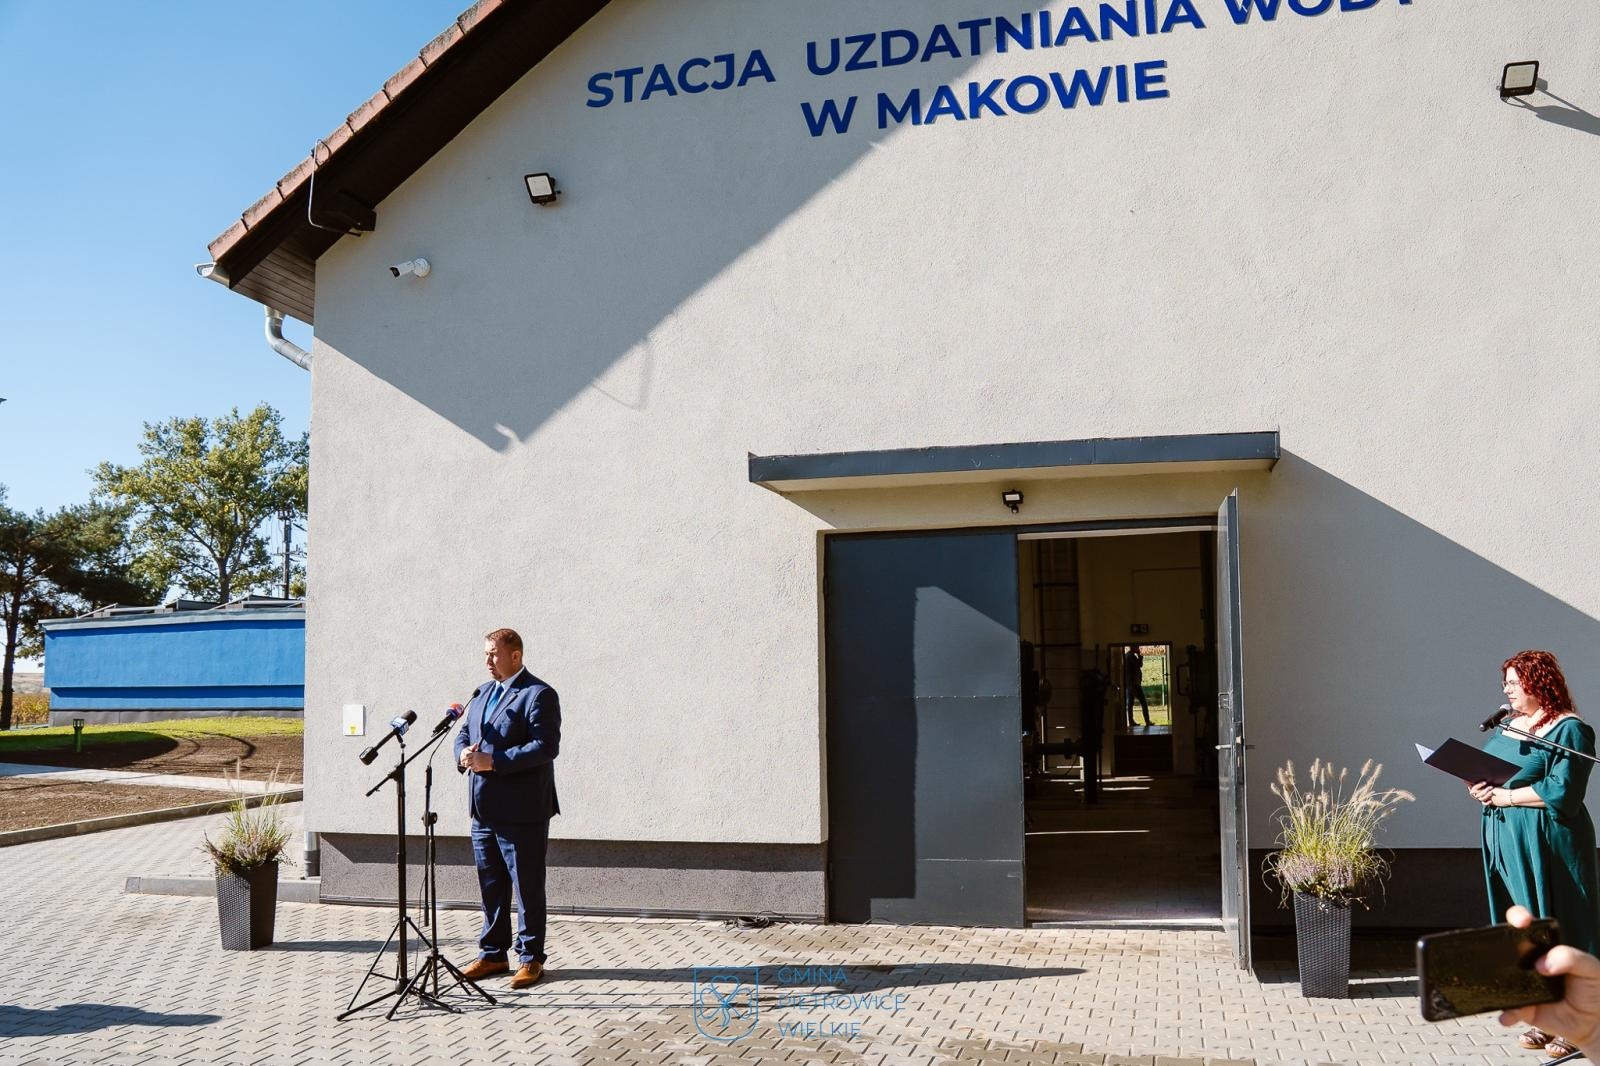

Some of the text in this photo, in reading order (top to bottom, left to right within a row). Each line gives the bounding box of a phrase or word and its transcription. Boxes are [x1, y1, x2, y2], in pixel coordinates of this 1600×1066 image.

[587, 0, 1206, 108] STACJA UZDATNIANIA
[801, 60, 1169, 137] W MAKOWIE
